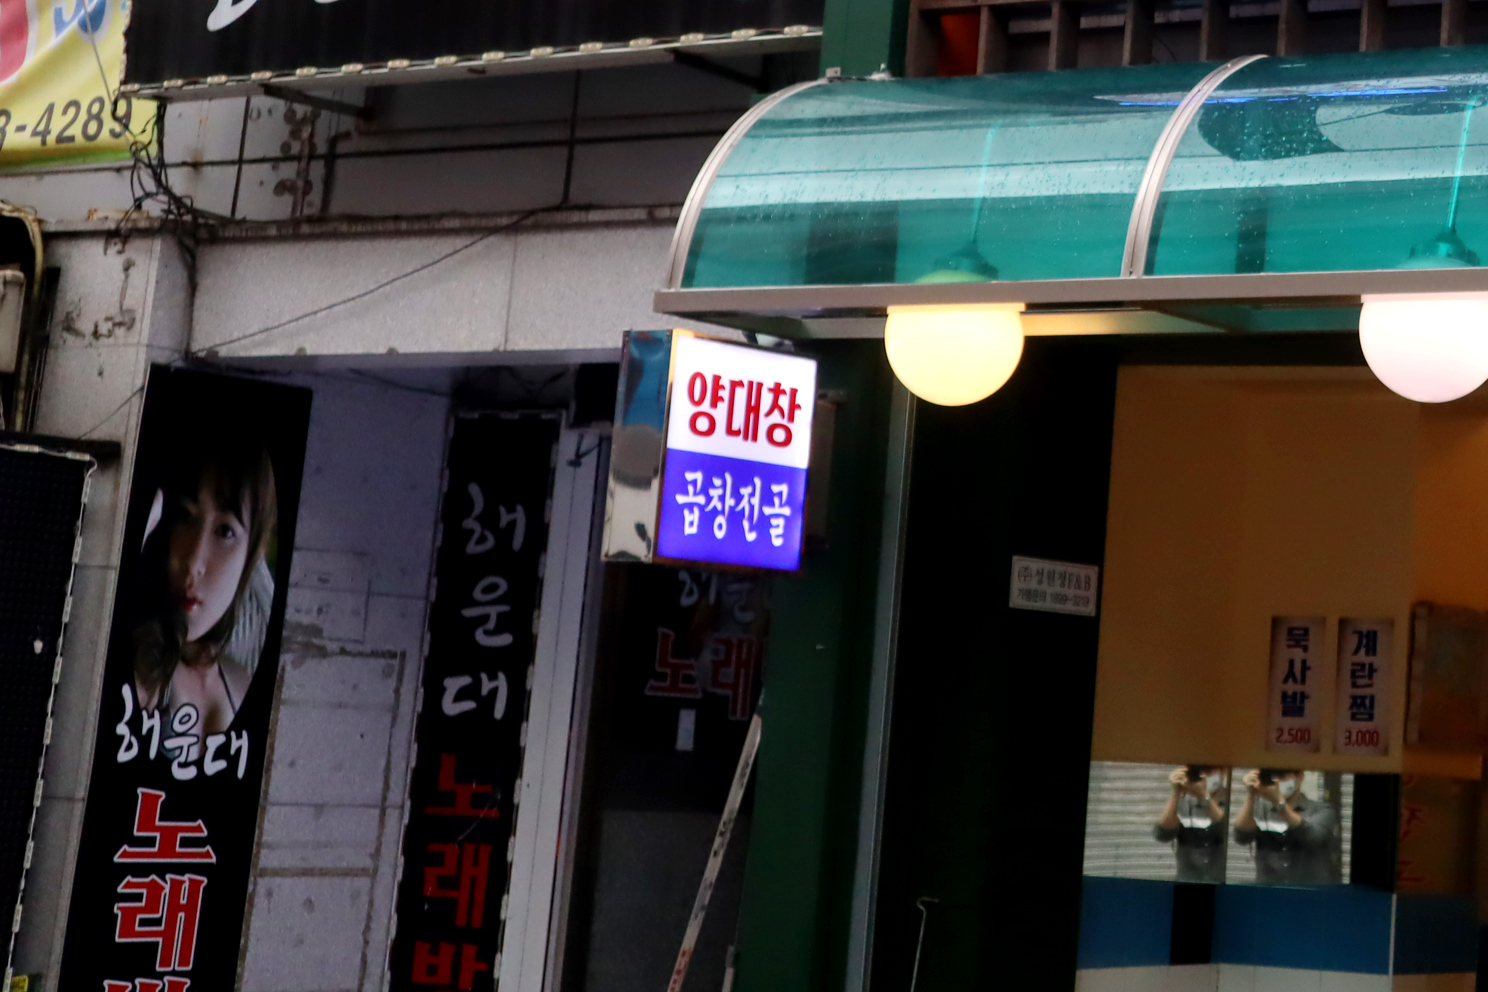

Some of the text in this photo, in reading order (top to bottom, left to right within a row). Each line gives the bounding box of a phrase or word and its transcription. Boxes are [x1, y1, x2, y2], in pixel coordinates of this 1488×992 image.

[687, 370, 803, 449] 양대창
[674, 470, 795, 549] 곱창전골
[442, 481, 527, 721] 해운대
[1279, 625, 1312, 719] 묵사발
[1347, 628, 1379, 723] 계란찜
[1275, 727, 1312, 746] 2,500
[1343, 729, 1381, 748] 3,000
[105, 683, 249, 992] 해운대 노래
